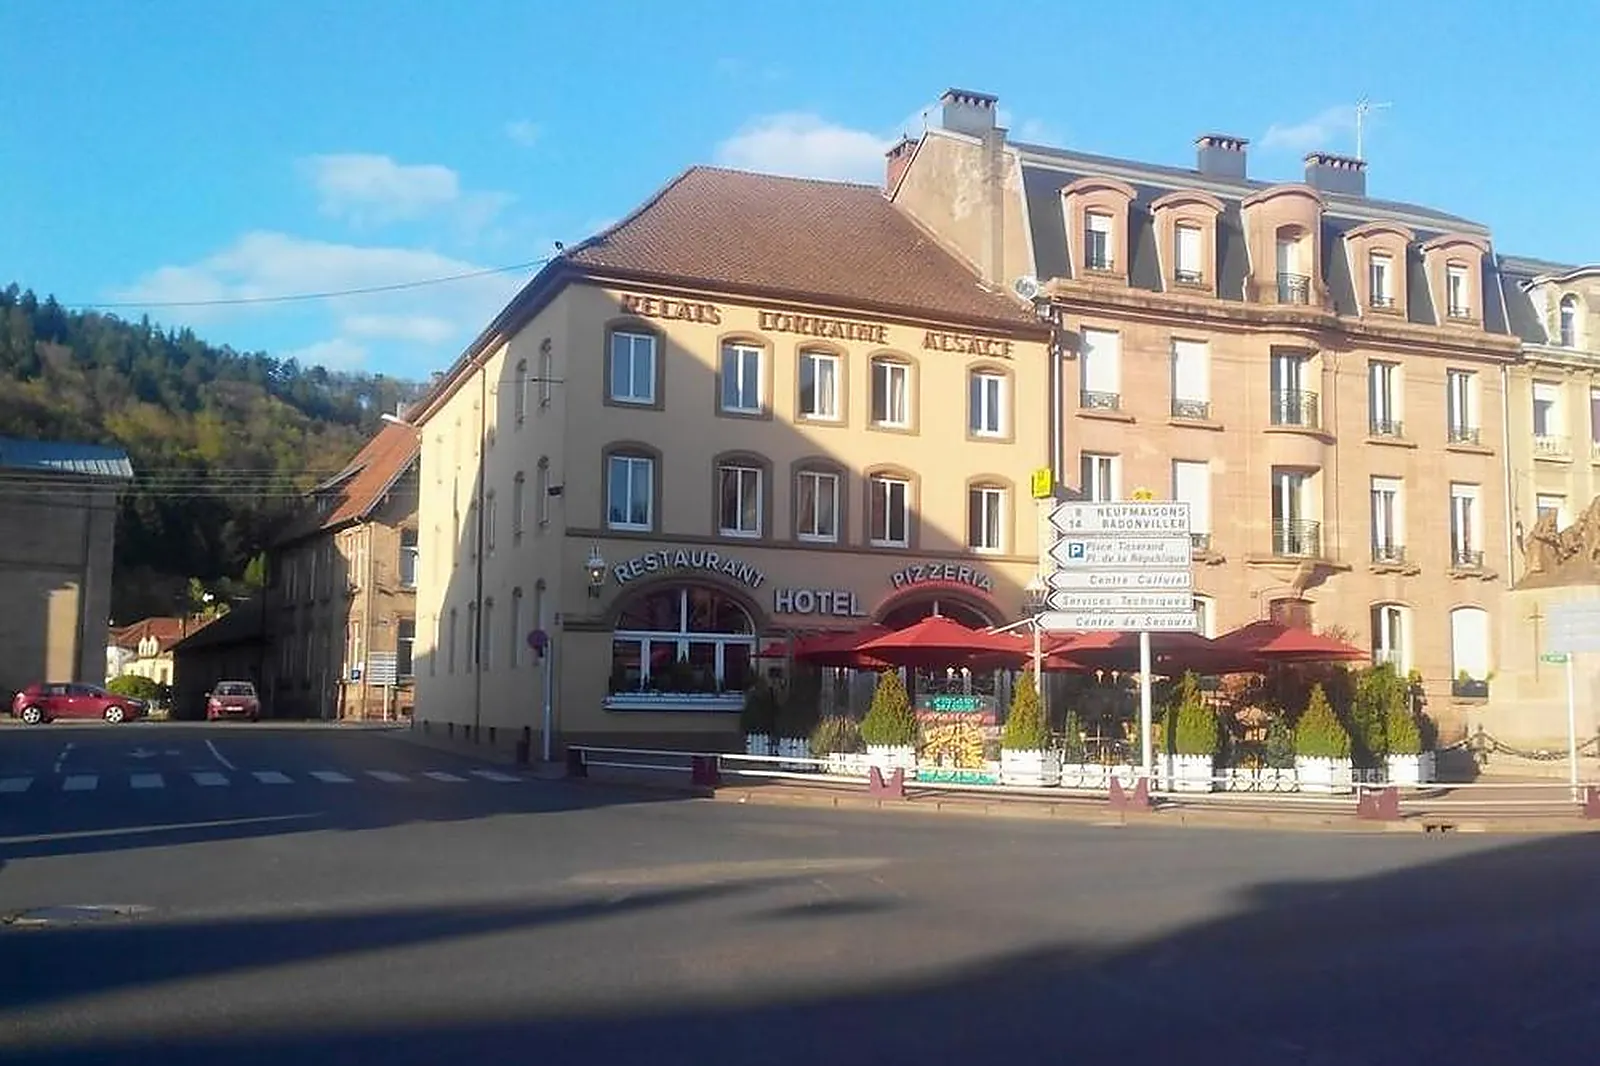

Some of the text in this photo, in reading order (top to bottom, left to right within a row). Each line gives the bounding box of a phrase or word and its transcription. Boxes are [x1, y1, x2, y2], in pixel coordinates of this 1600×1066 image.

[621, 293, 721, 325] RELAIS
[759, 309, 889, 345] LORRAINE
[922, 331, 1015, 360] ALSACE
[613, 548, 765, 588] RESTAURANT
[892, 562, 994, 590] PIZZERIA
[774, 588, 867, 617] HOTEL
